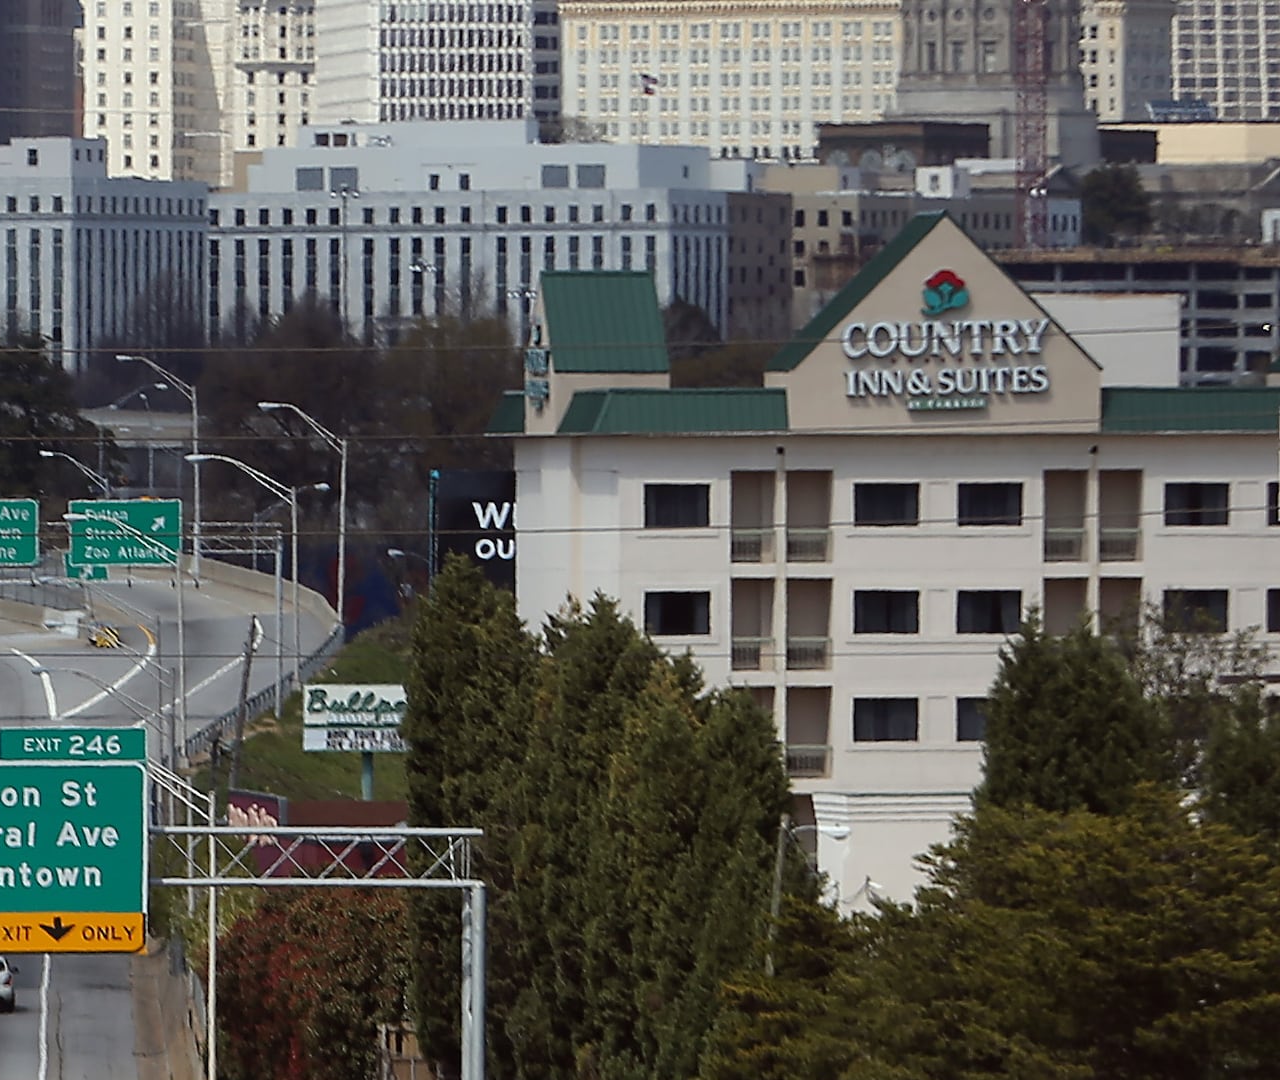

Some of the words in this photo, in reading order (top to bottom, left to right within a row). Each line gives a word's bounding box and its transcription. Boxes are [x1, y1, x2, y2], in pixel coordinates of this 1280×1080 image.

[842, 318, 1049, 358] COUNTRY
[845, 368, 903, 397] INN
[907, 367, 932, 395] &
[938, 366, 1049, 395] SUITES
[0, 507, 30, 521] Ave
[85, 545, 110, 559] Zoo
[23, 737, 62, 752] EXIT
[69, 735, 121, 755] 246
[61, 781, 97, 807] St
[56, 821, 119, 848] Ave
[82, 925, 136, 941] ONLY
